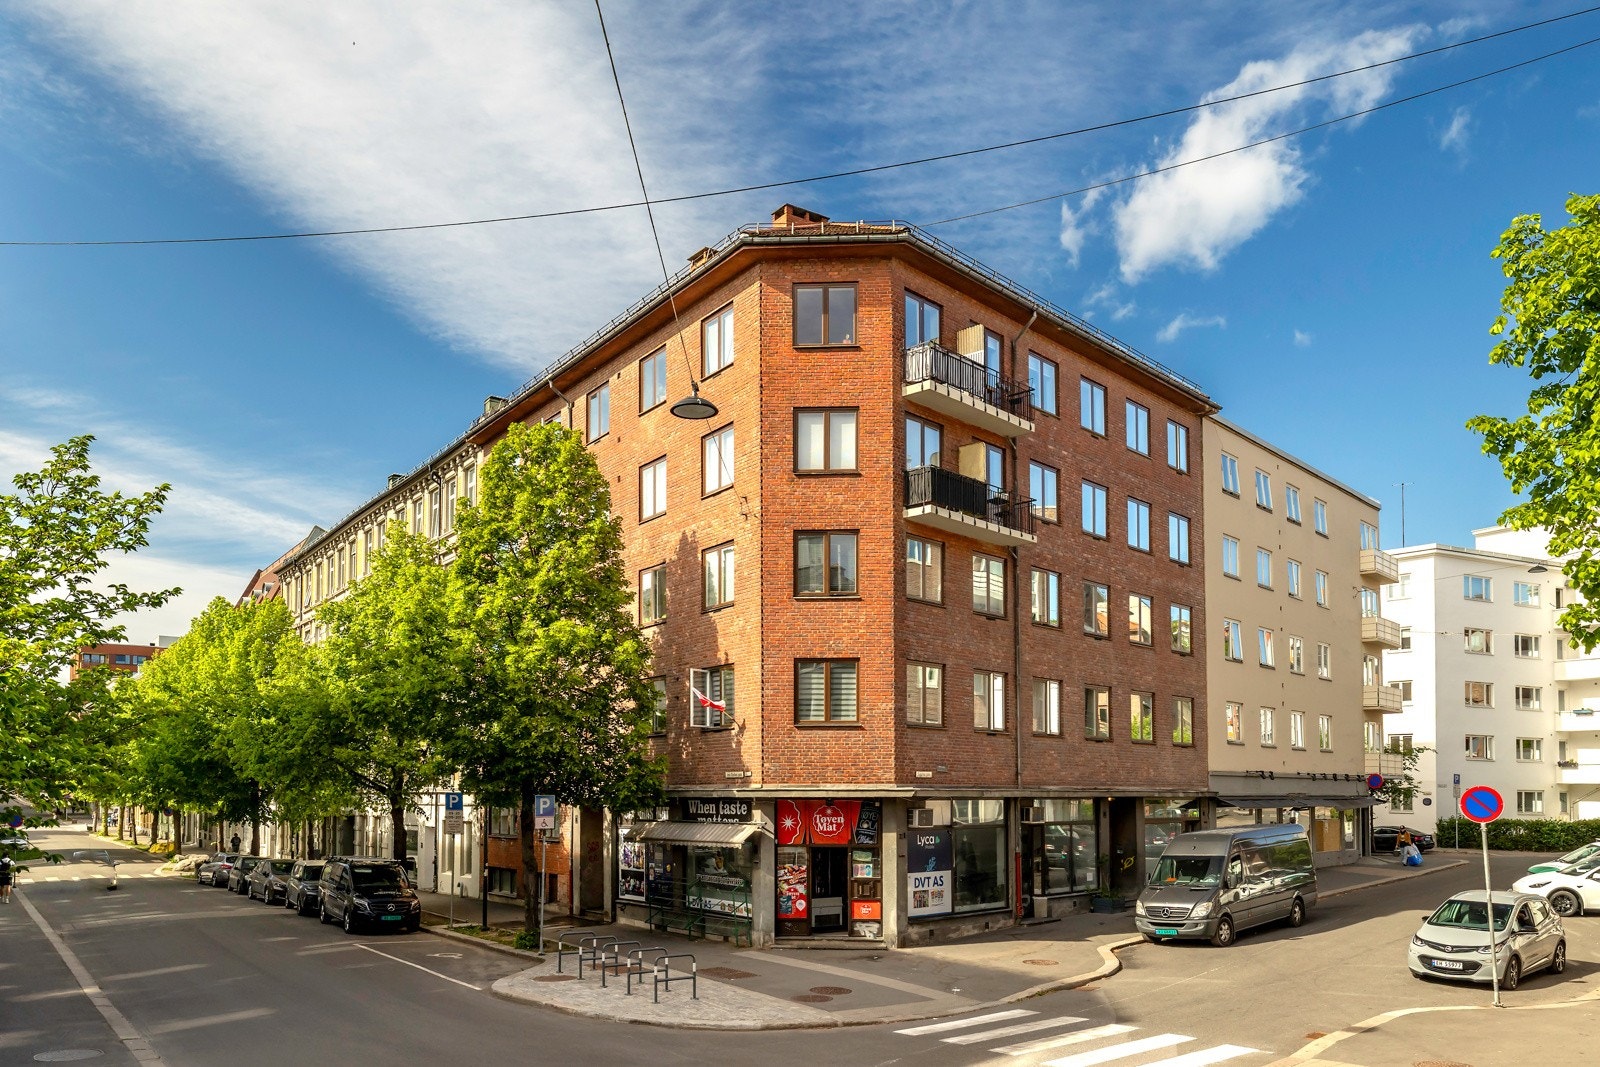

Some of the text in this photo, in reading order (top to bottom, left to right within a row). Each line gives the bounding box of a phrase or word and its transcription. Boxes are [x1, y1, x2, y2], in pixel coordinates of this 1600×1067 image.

[450, 794, 458, 808] P
[540, 798, 550, 814] P
[688, 800, 748, 815] When taste
[818, 823, 837, 832] Mat
[917, 834, 934, 846] Lyca
[914, 876, 944, 888] DVT AS
